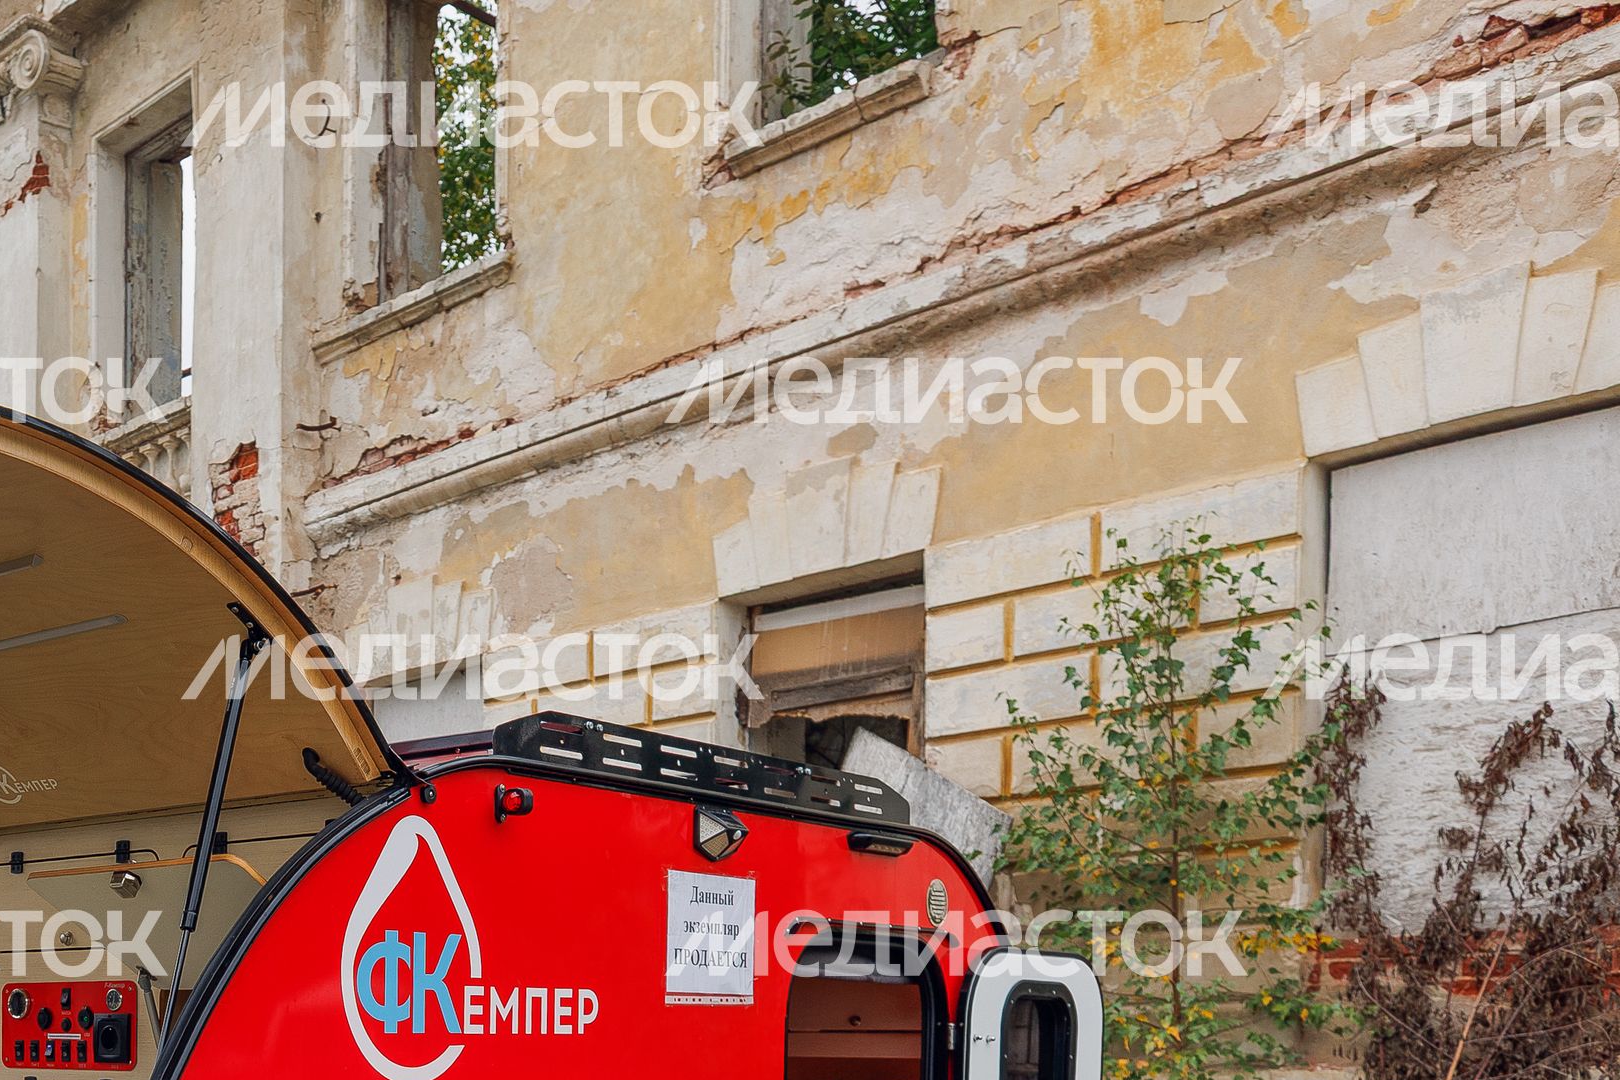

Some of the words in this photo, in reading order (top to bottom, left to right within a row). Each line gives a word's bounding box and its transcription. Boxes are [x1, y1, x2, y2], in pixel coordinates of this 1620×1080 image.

[689, 885, 734, 908] Данный
[683, 920, 740, 941] экземпляр
[673, 947, 748, 970] ПРОДАЕТСЯ
